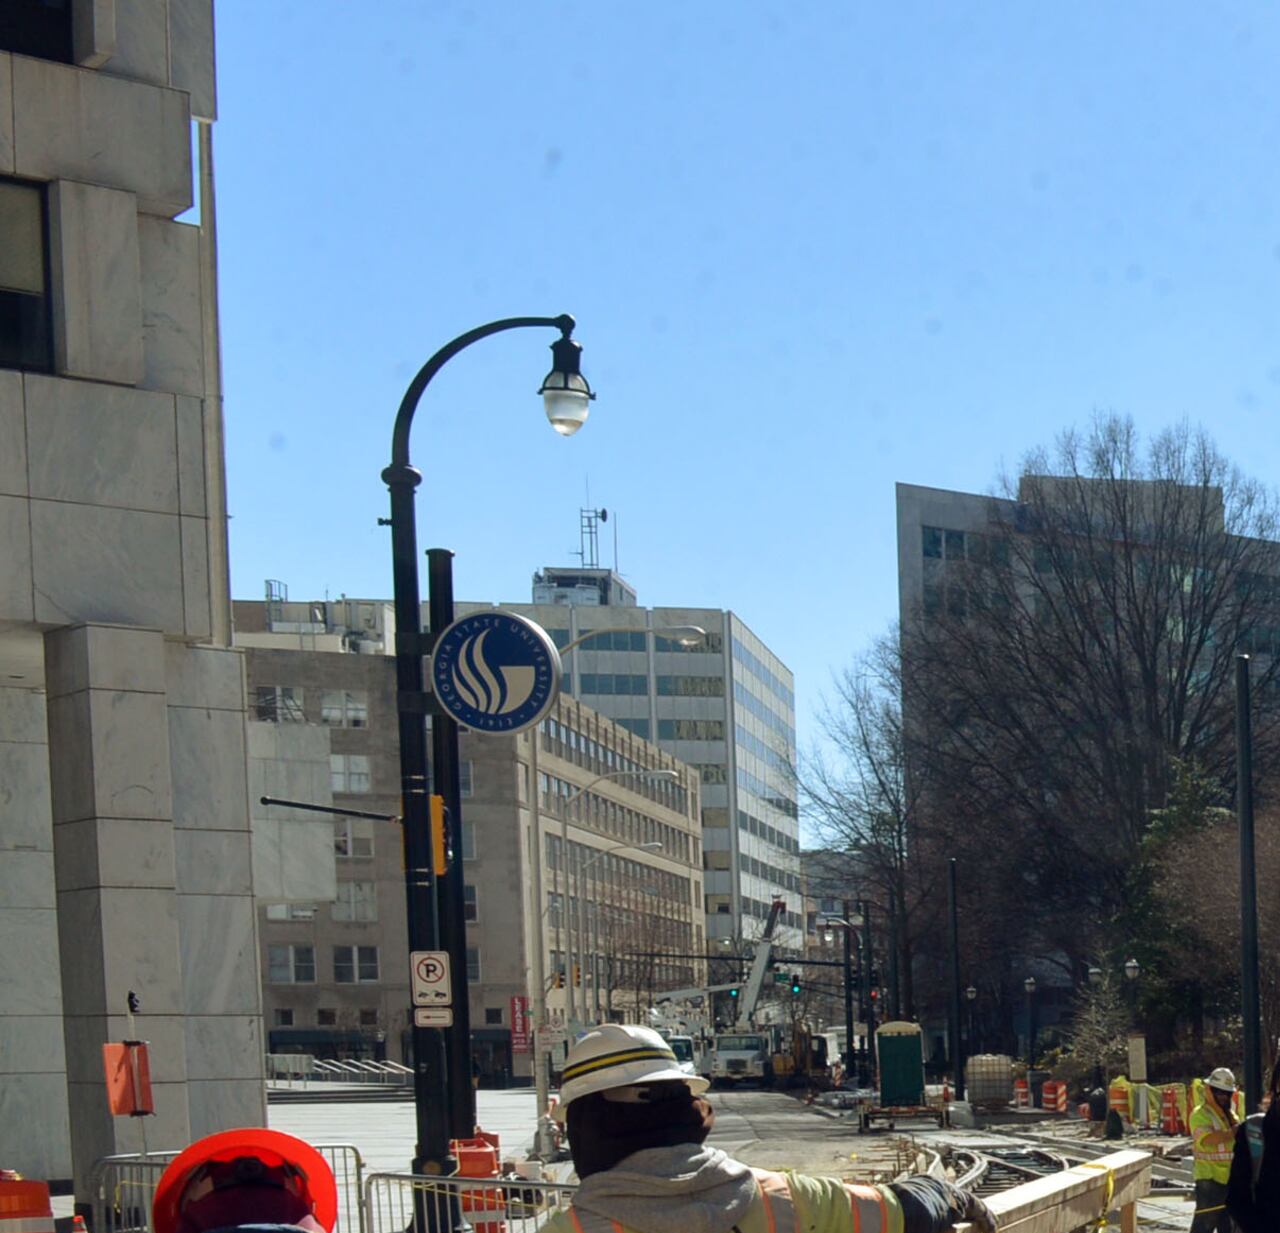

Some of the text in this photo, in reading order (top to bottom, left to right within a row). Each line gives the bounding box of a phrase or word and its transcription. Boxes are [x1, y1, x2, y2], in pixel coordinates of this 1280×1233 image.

[439, 618, 548, 710] GEORGIA STATE UNIVERSITY
